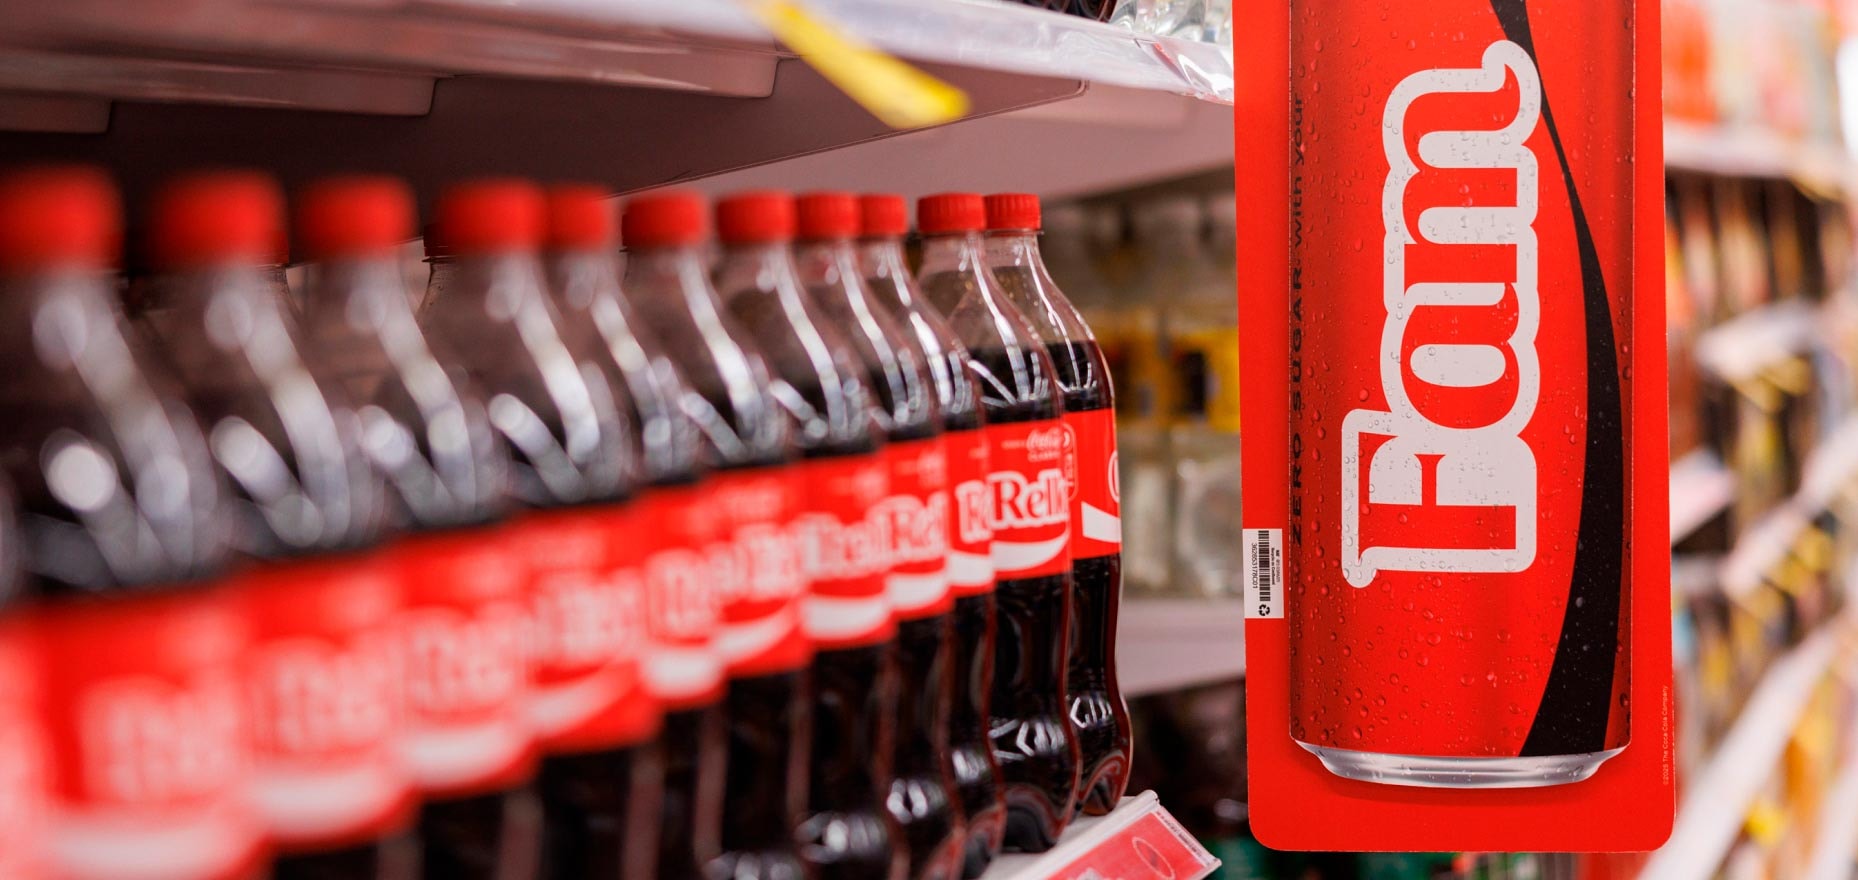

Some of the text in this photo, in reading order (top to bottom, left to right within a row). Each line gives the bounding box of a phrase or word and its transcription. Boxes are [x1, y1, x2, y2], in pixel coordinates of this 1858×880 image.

[1292, 94, 1304, 546] ZERO SUGAR with your
[1342, 40, 1541, 587] Fam
